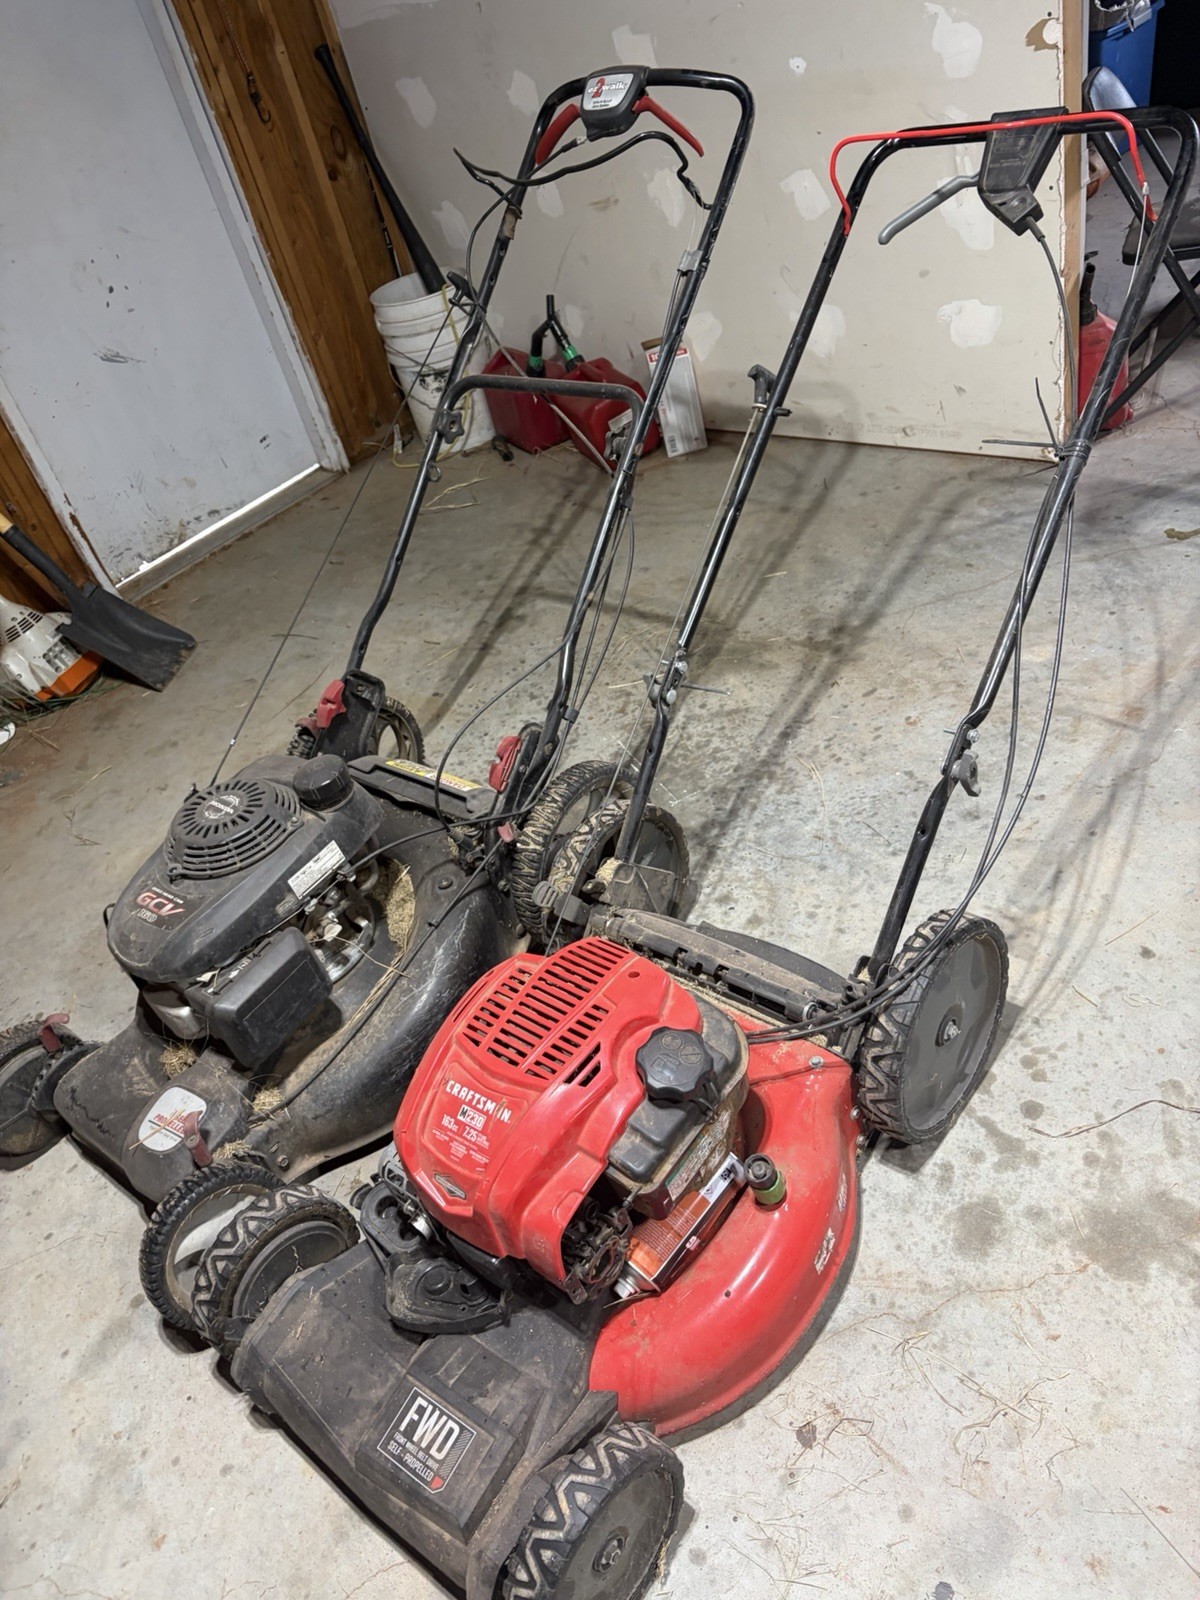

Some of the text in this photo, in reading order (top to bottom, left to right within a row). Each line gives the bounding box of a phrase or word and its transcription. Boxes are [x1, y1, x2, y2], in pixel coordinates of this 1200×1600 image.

[209, 799, 234, 813] HONDA
[136, 892, 185, 917] GCV
[137, 909, 157, 923] 160
[153, 1113, 185, 1134] PROELLE
[459, 1107, 484, 1127] M230
[463, 1125, 478, 1142] 7.25
[398, 1396, 460, 1460] FWD
[387, 1440, 402, 1455] SELF
[403, 1453, 435, 1482] PROPELLED
[393, 1432, 439, 1471] FRONT WHEEL BELT DRIVE
